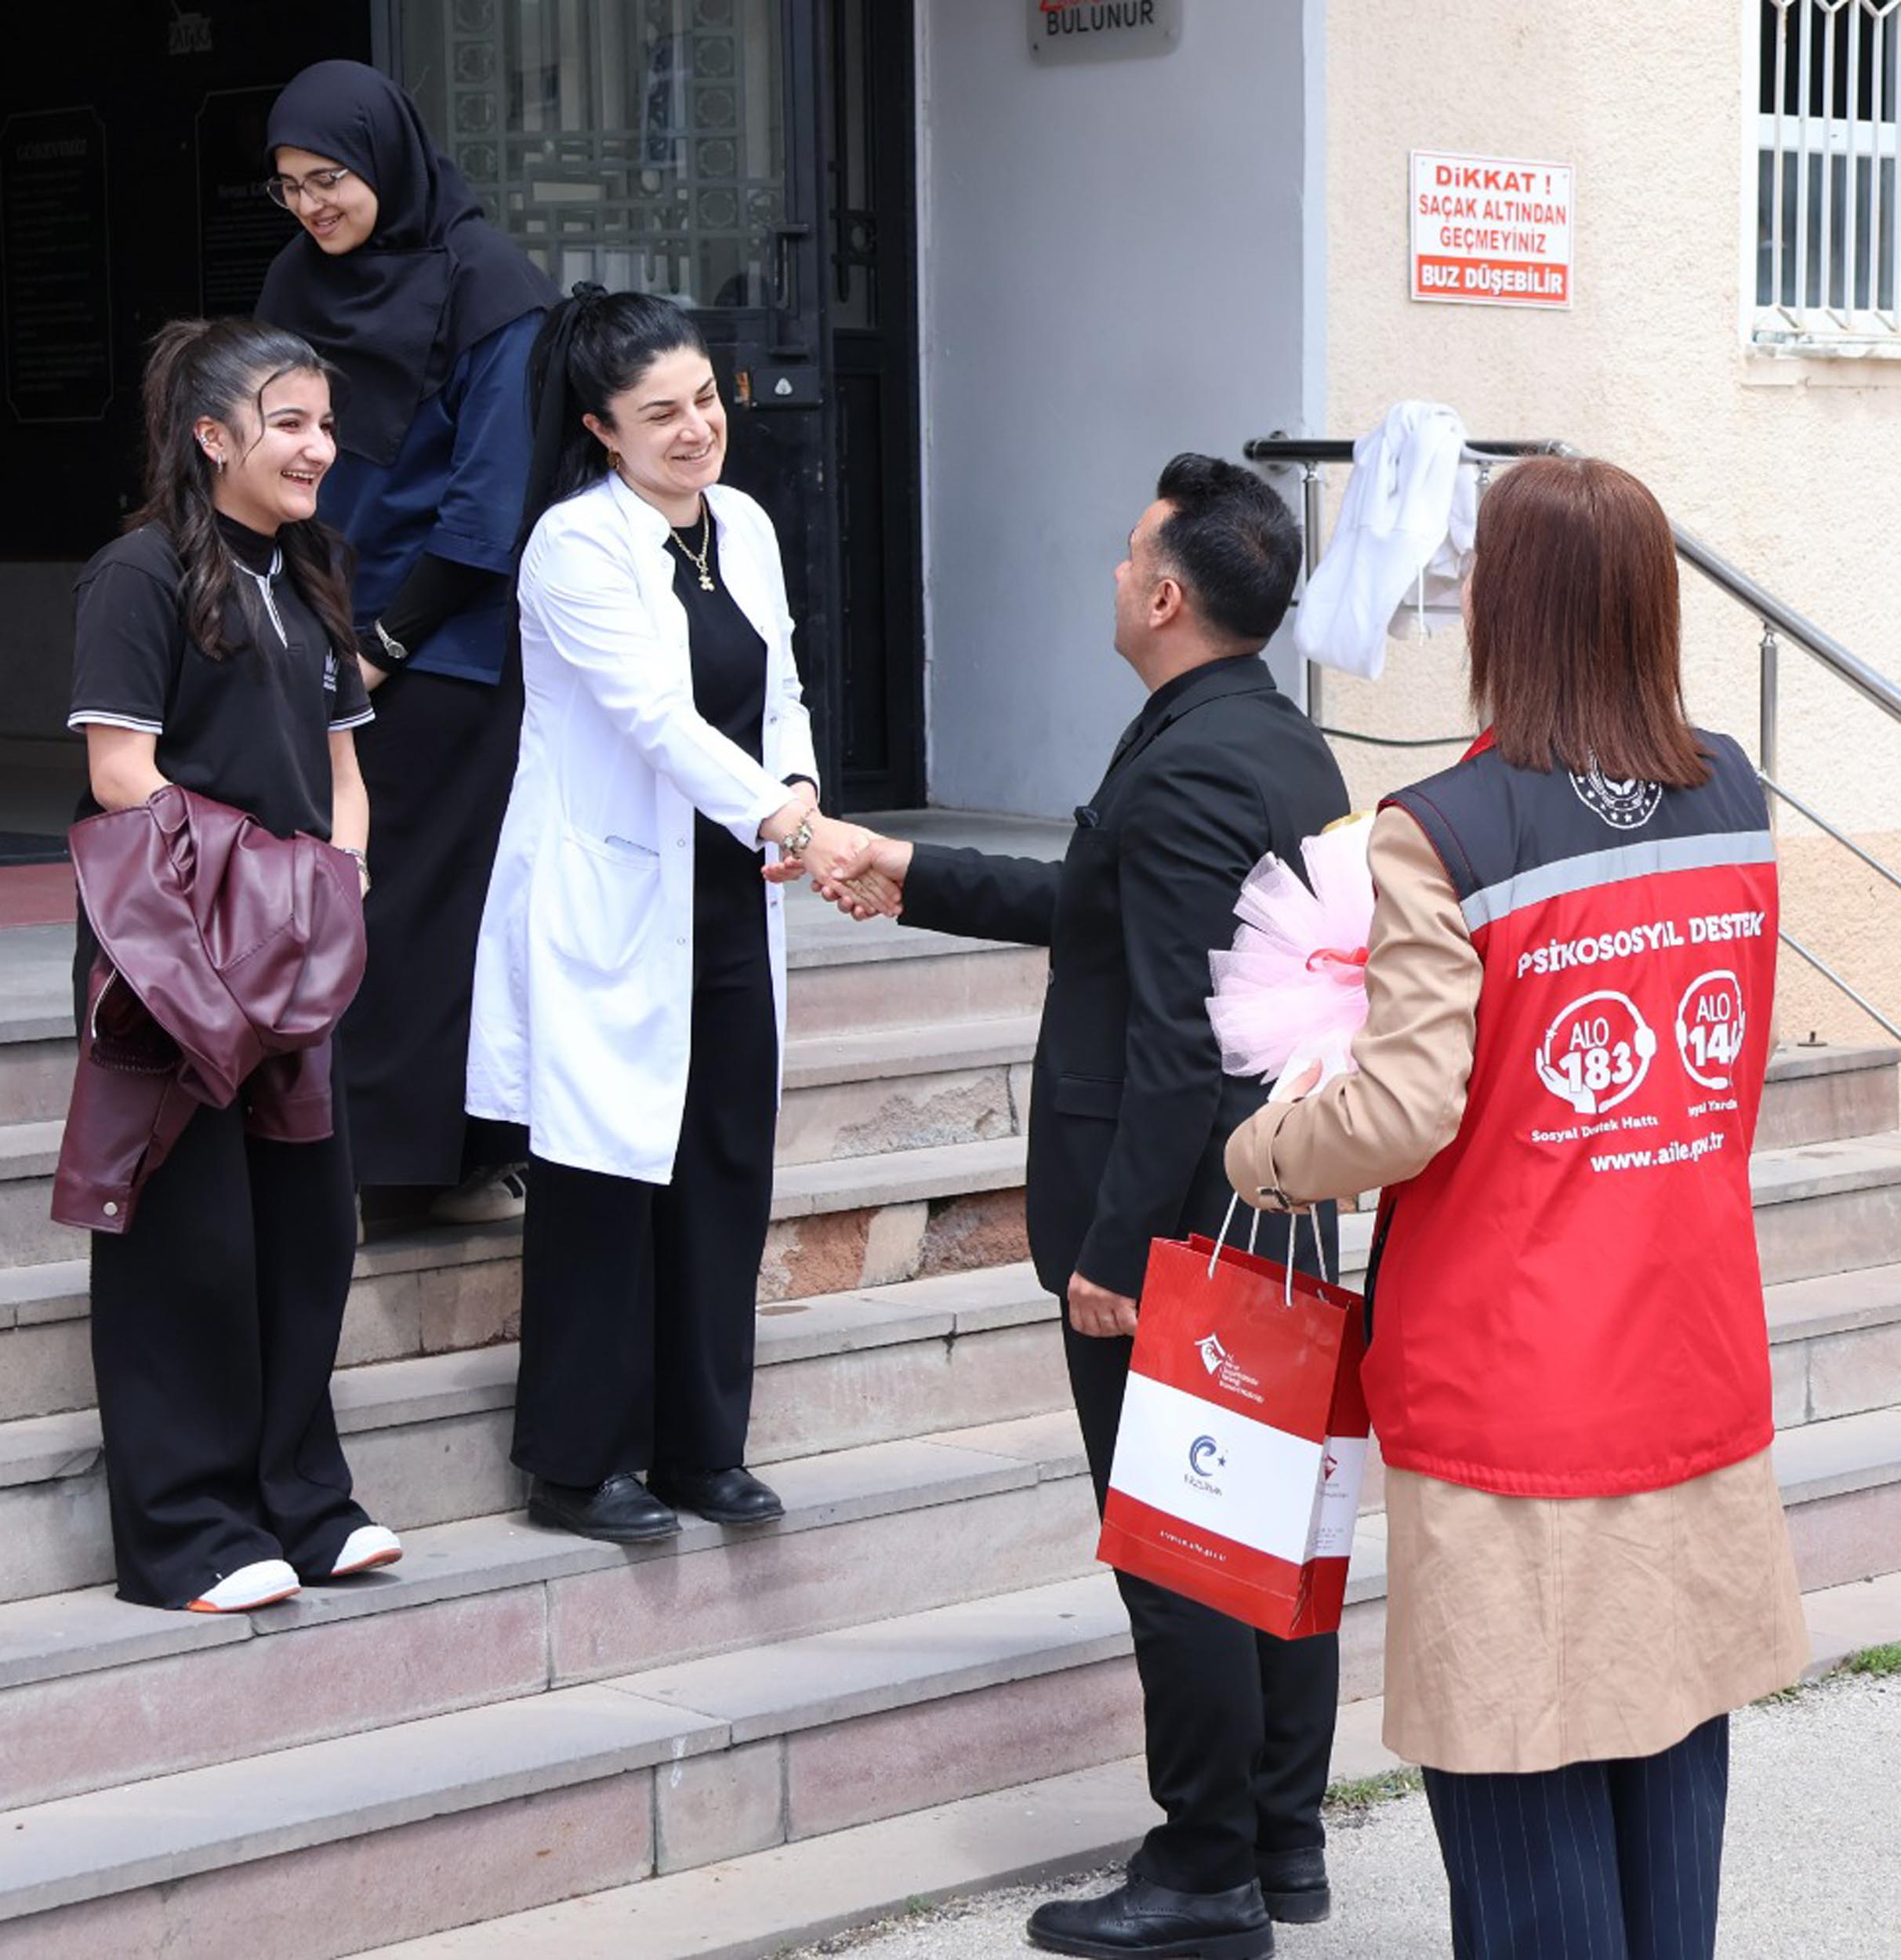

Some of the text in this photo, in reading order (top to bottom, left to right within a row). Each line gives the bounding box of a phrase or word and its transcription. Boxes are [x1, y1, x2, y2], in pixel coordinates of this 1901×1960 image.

[1047, 0, 1154, 35] BULUNUR
[1419, 194, 1567, 226] SAÇAK ALTINDAN
[1439, 225, 1547, 255] GEÇMEYİNİZ
[1421, 263, 1564, 296] BUZ DÜŞEBİLİR
[1688, 911, 1765, 944] DESTEK
[1695, 991, 1731, 1024] ALO
[1569, 1016, 1609, 1051] ALO
[1558, 1040, 1634, 1094] 183
[1531, 1127, 1578, 1143] Sosyal
